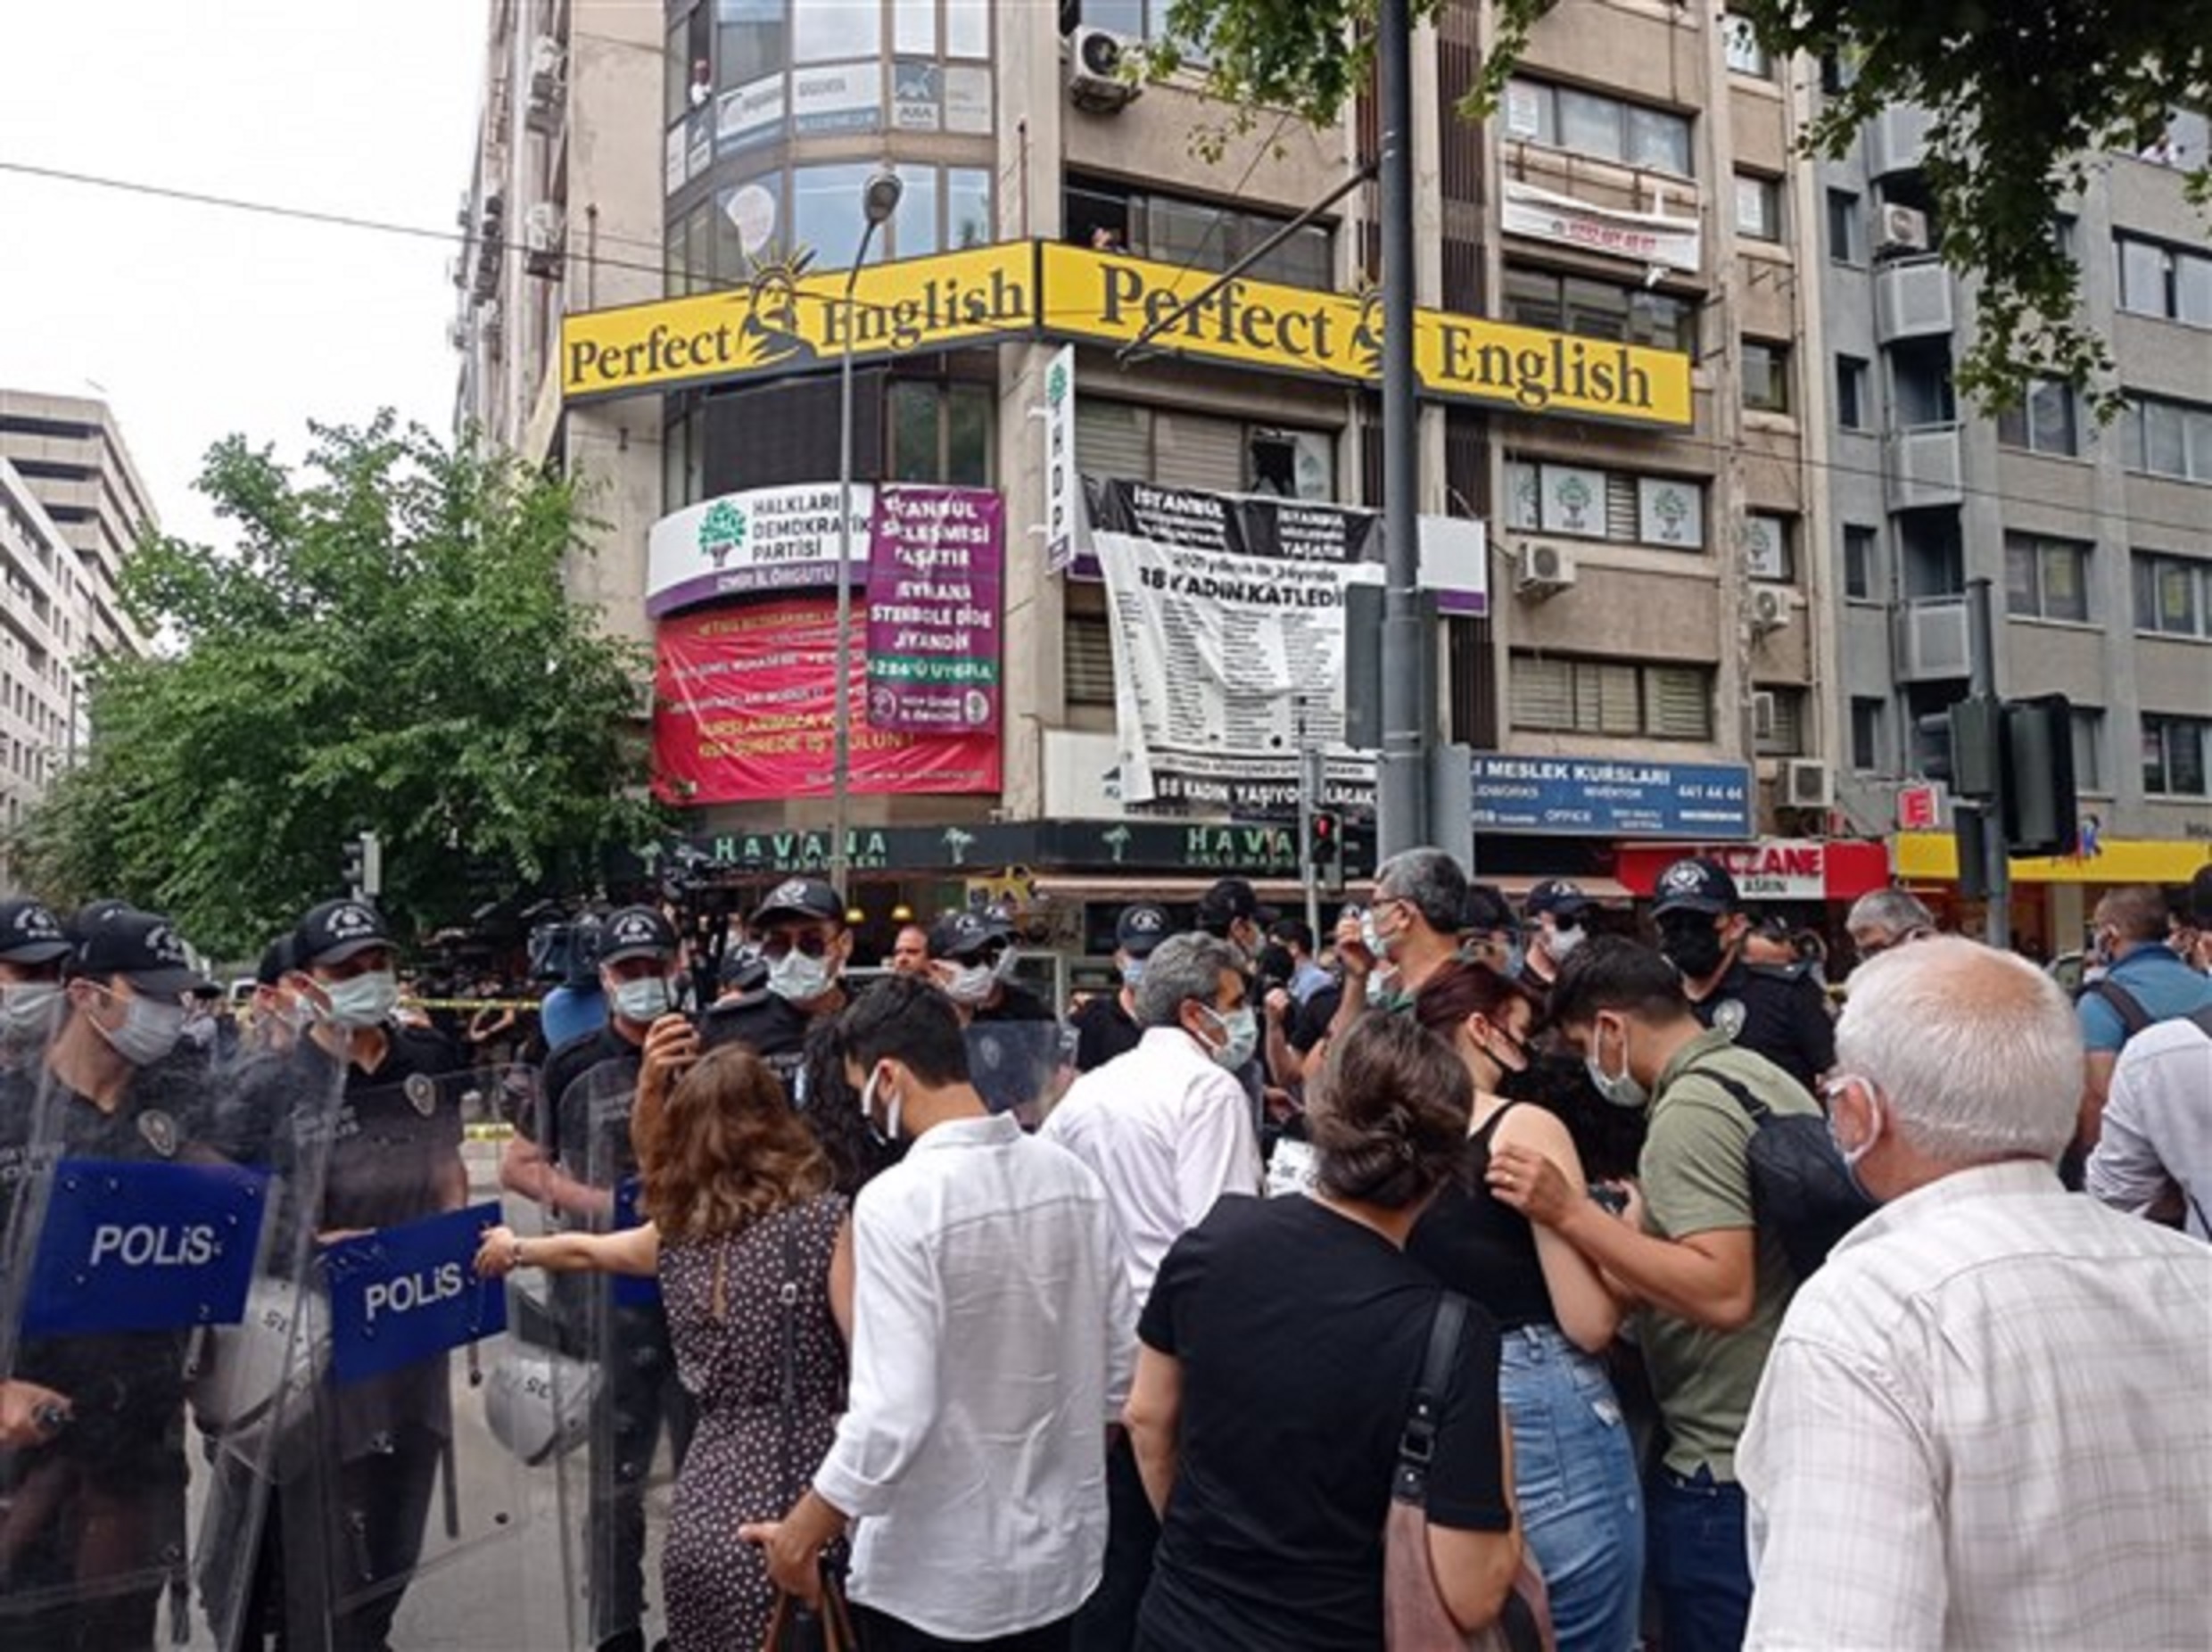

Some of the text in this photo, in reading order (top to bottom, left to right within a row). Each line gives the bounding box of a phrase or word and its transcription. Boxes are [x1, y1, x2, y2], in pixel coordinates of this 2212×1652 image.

[569, 268, 1025, 384] Perfect English
[1099, 263, 1653, 409] Perfect English
[752, 492, 851, 516] HALKLARI
[752, 512, 871, 539] DEMOKRAİK
[1249, 581, 1342, 608] KATLEDİ
[1487, 761, 1570, 781] MESLEK
[1187, 827, 1293, 855] HAVA
